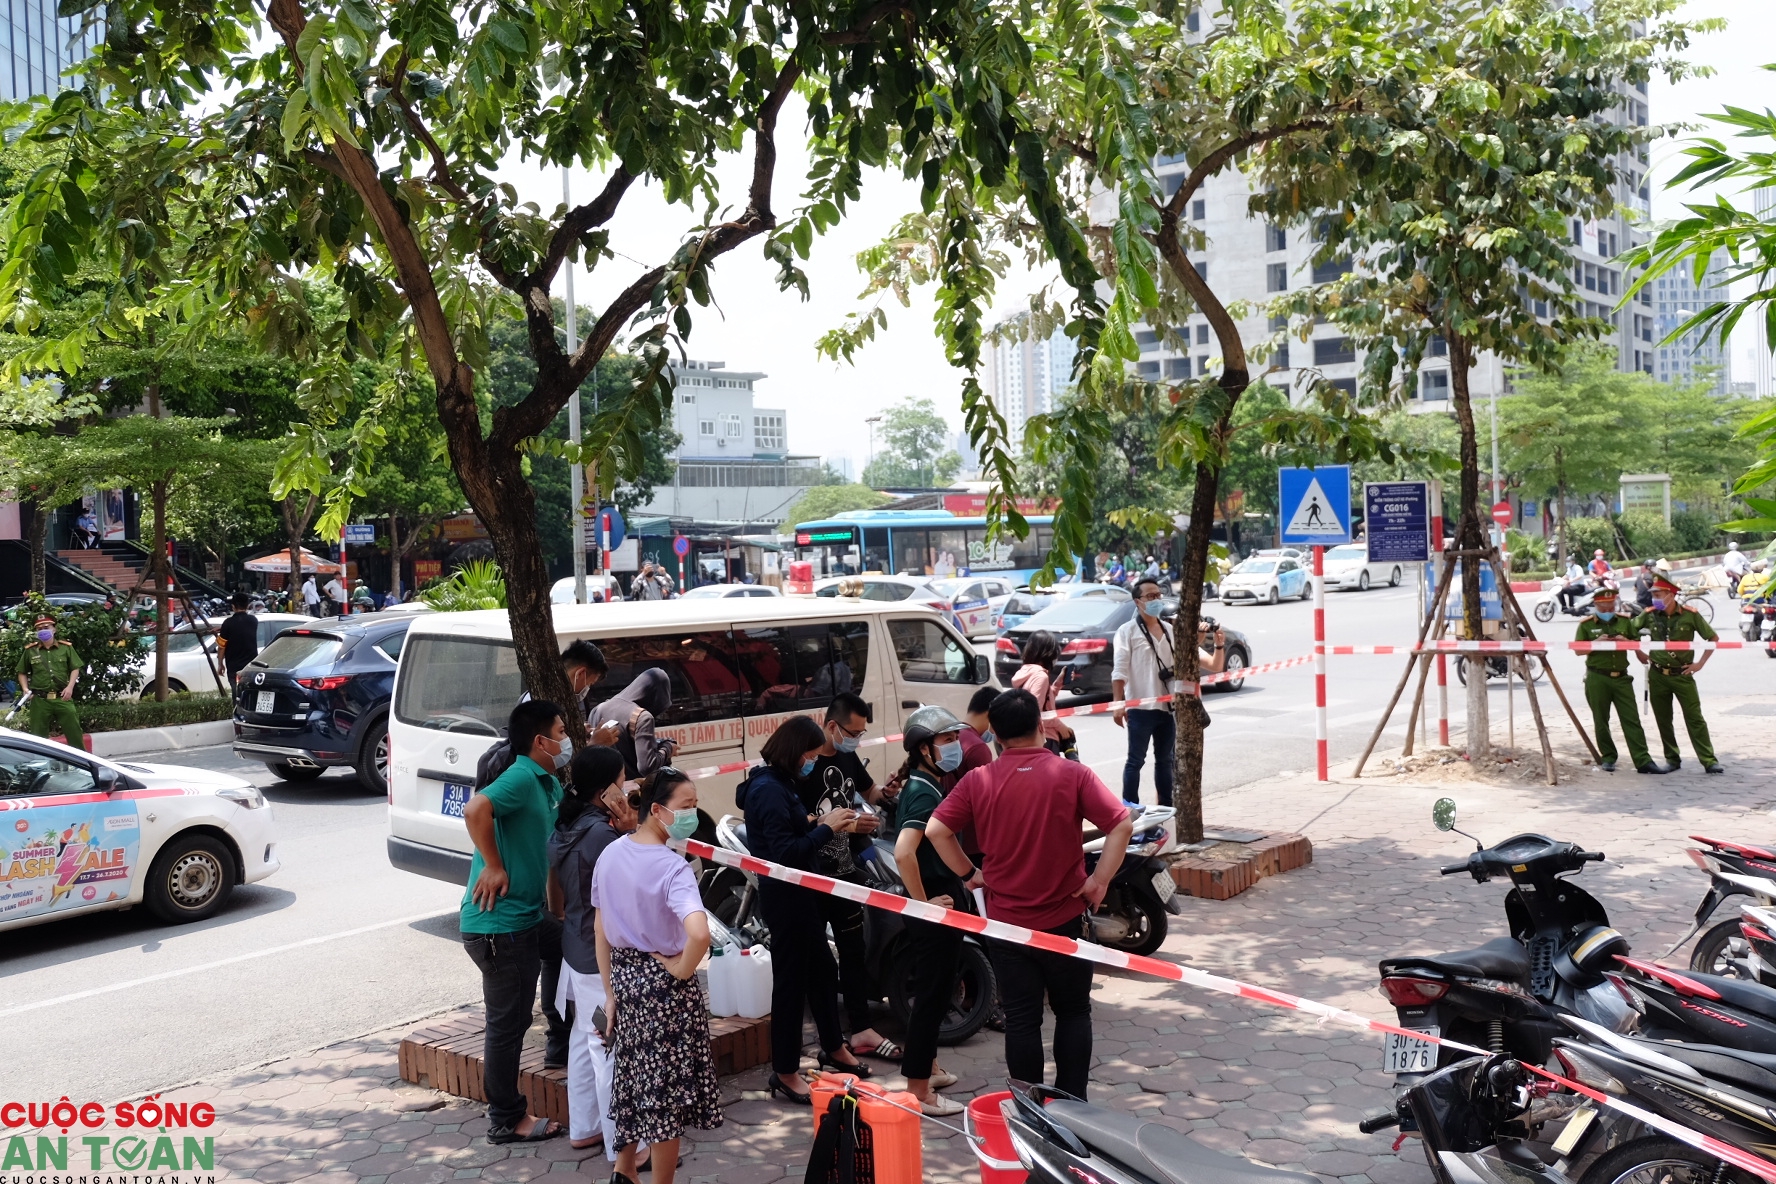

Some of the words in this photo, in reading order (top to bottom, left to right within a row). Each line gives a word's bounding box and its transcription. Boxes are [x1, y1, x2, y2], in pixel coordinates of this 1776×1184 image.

[1383, 503, 1409, 512] CG016
[689, 722, 716, 744] TÂM
[718, 723, 725, 740] Y
[747, 715, 779, 738] QUẬN
[449, 784, 464, 801] 31A
[12, 847, 56, 861] SUMMER
[1680, 999, 1748, 1029] VISION
[1391, 1050, 1428, 1070] 1876
